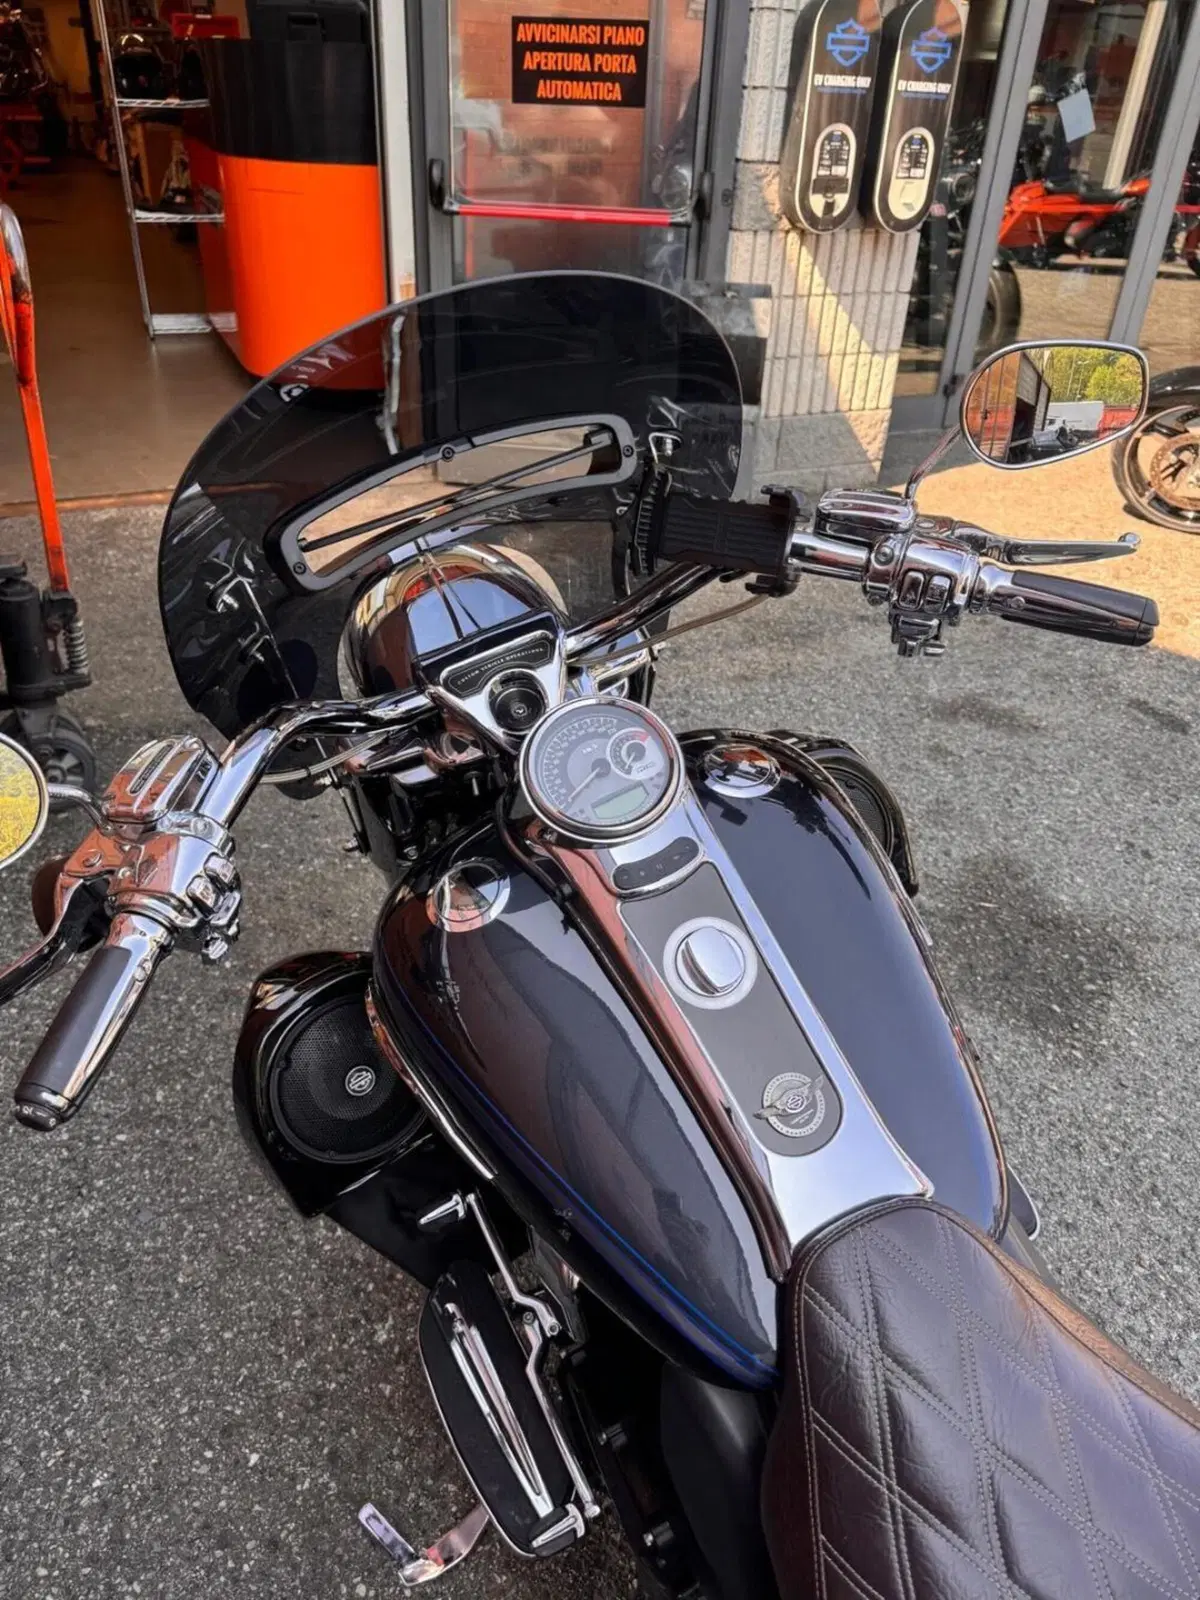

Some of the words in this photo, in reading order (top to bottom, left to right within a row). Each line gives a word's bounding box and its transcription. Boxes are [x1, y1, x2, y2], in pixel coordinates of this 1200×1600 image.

[516, 23, 601, 45] AVVICINARSI
[603, 25, 645, 46] PIANO
[523, 51, 592, 72] APERTURA
[594, 53, 637, 74] PORTA
[536, 79, 622, 101] AUTOMATICA
